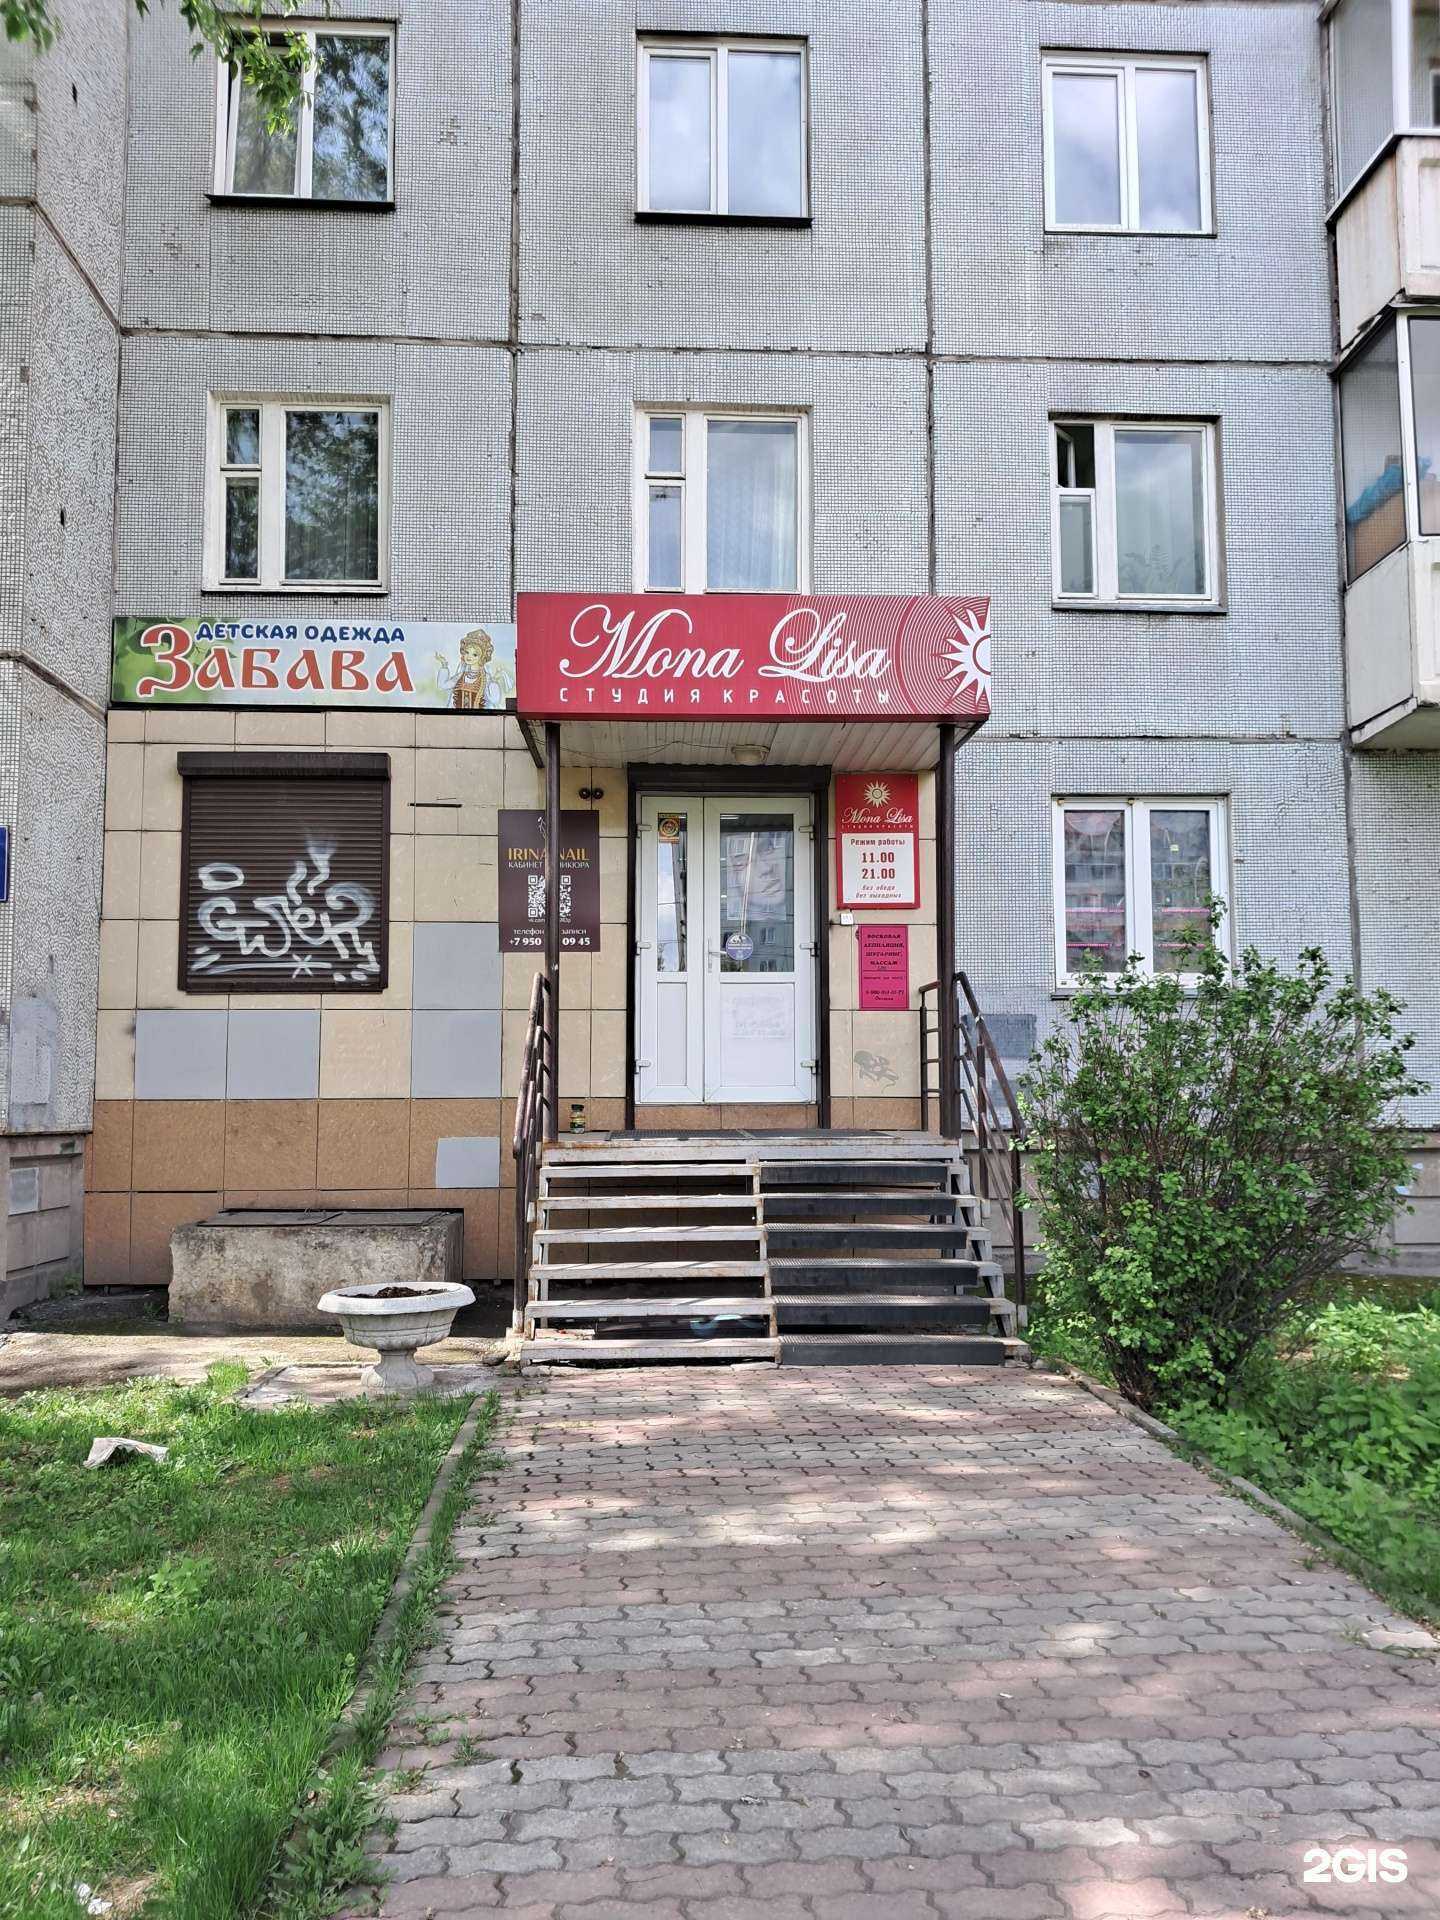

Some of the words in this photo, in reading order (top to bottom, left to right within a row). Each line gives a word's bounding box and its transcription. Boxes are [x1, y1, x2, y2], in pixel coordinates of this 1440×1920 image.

[196, 622, 298, 641] ДЕТСКАЯ
[304, 625, 406, 644] ОДЕЖДА
[559, 604, 744, 679] Mona
[758, 608, 892, 683] Lisa
[136, 623, 416, 697] ЗАБАВА
[560, 687, 701, 704] СТУДИЯ
[722, 687, 890, 704] КРАСОТЫ
[842, 807, 880, 824] Mona
[885, 807, 914, 824] Lisa
[850, 838, 876, 846] Режим
[878, 838, 906, 847] работы
[508, 861, 543, 869] КАБИНЕТ
[862, 852, 895, 864] 11.00
[862, 868, 896, 880] 21.00
[522, 937, 542, 946] 950
[562, 937, 576, 946] 09
[578, 937, 591, 946] 45
